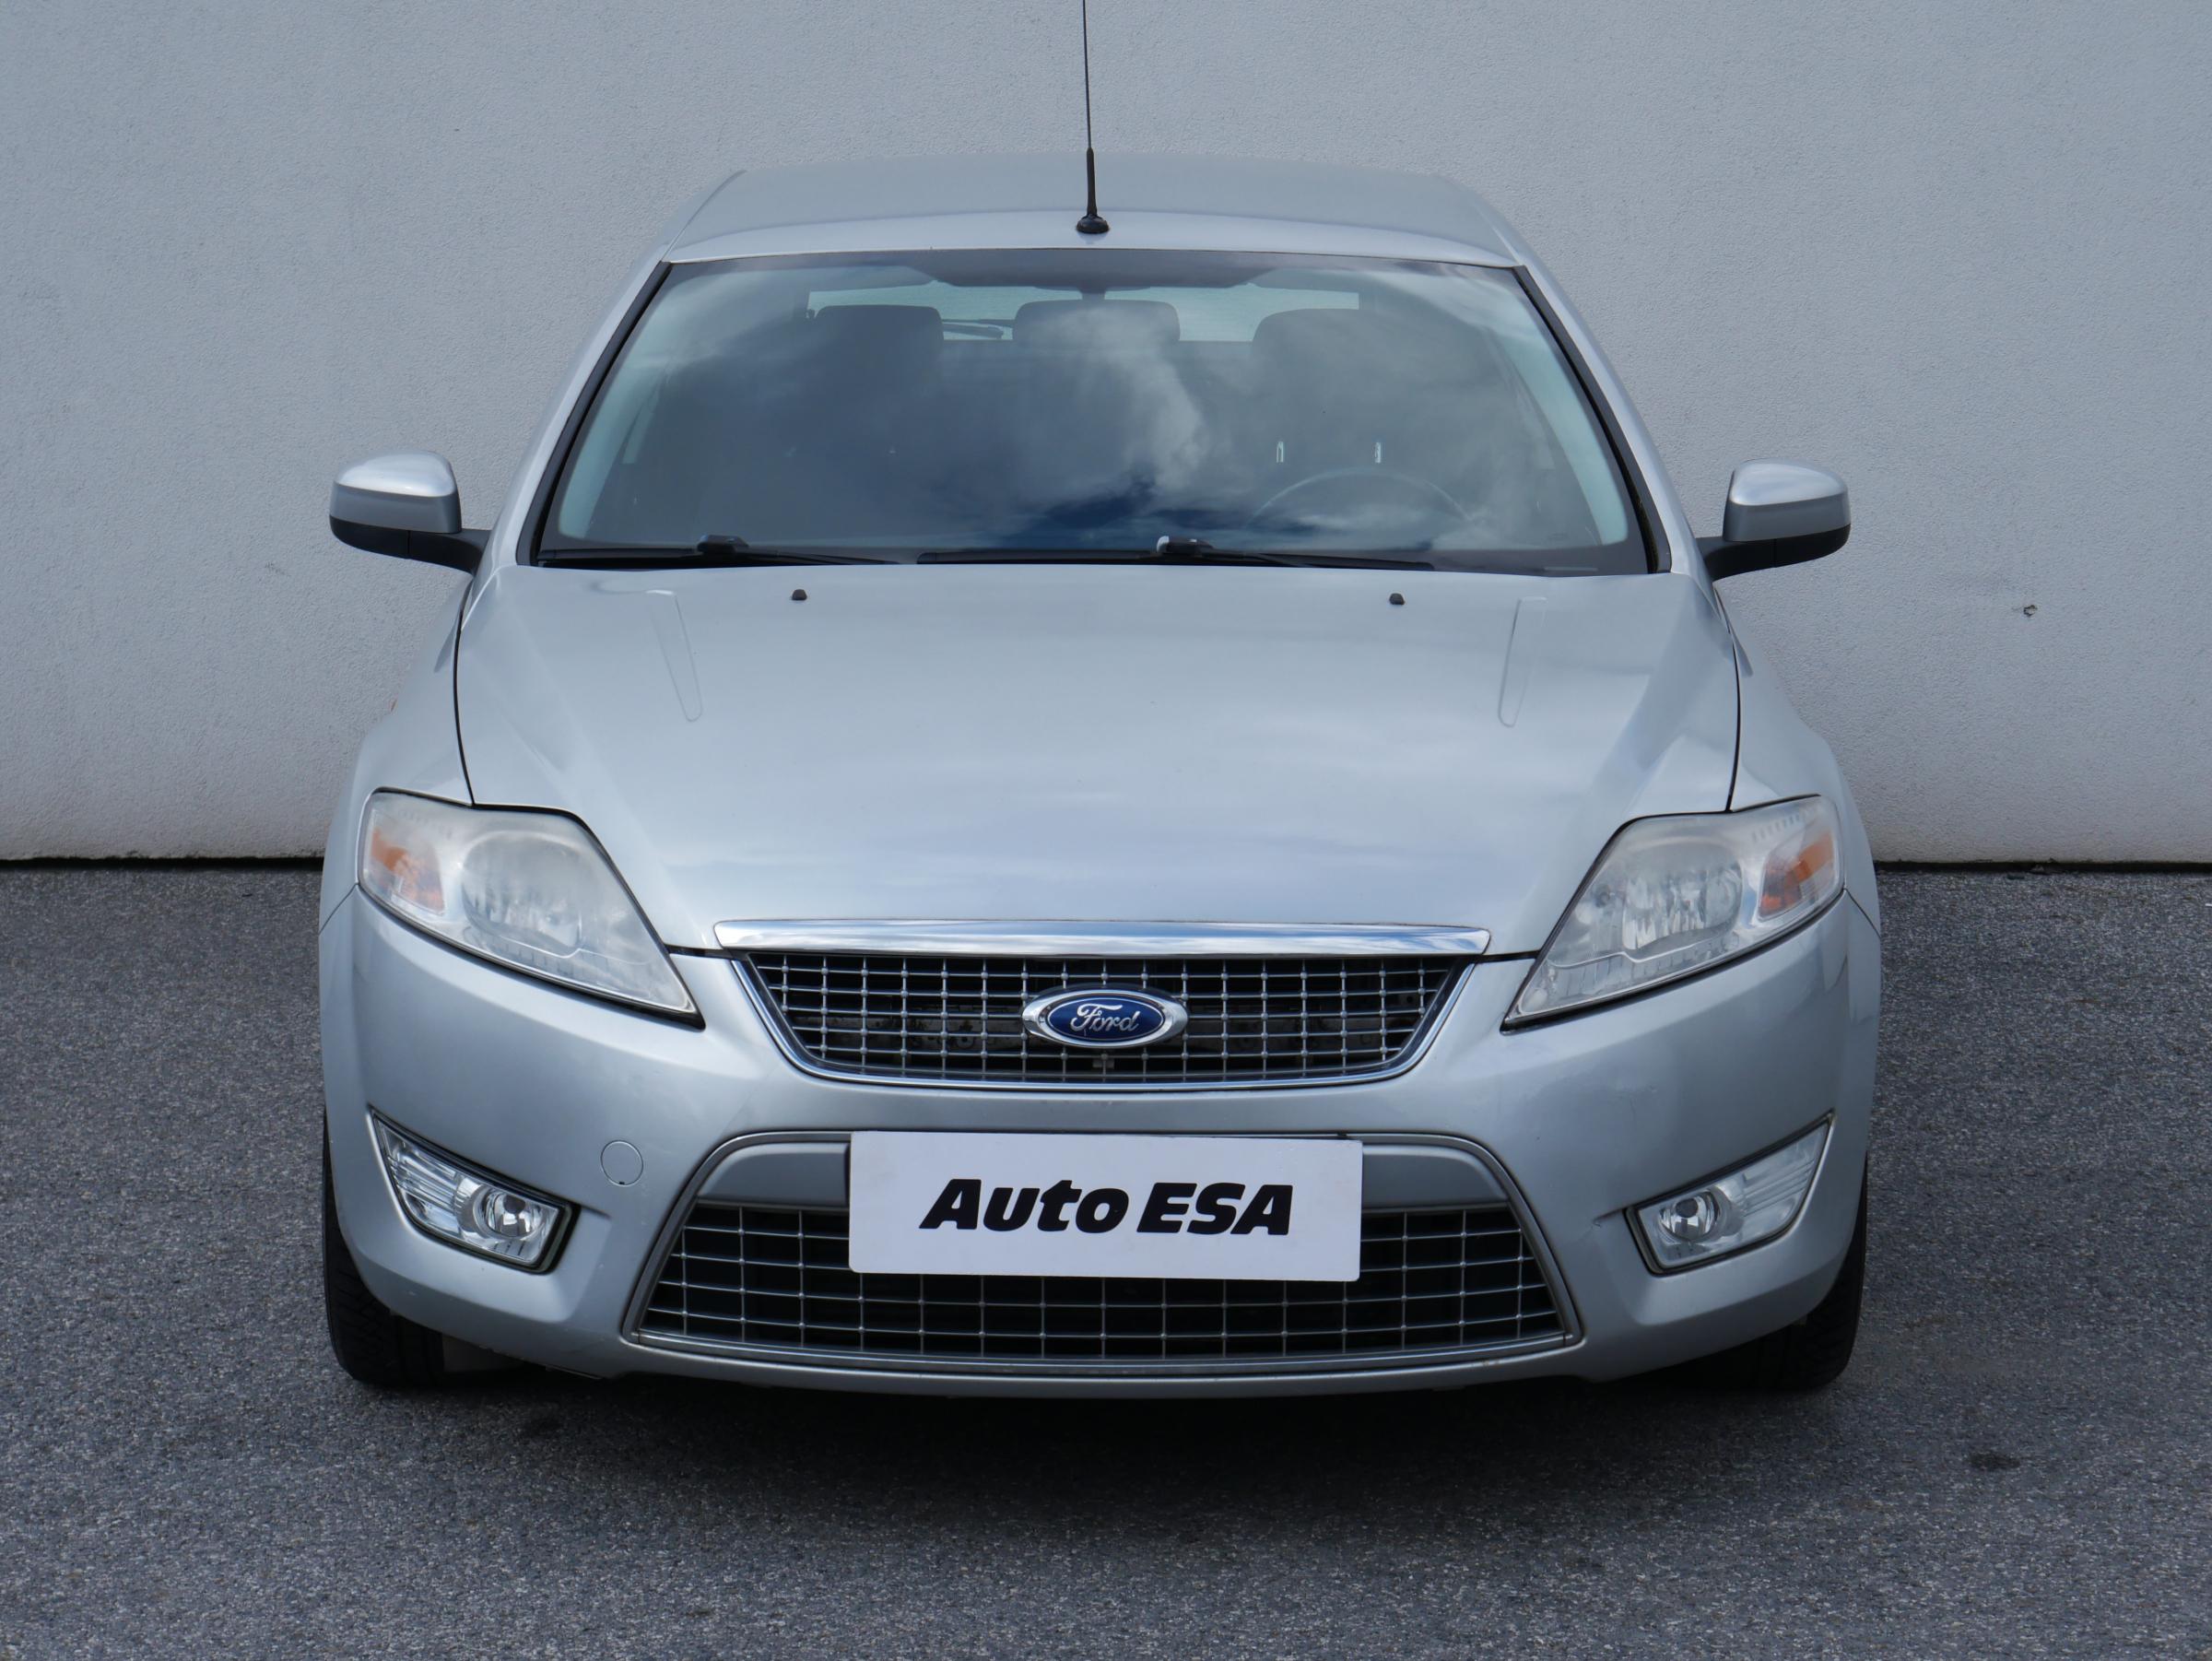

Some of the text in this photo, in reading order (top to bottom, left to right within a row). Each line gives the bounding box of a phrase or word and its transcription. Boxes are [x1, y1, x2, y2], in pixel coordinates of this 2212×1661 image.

[1070, 1003, 1140, 1032] Ford
[919, 1179, 1293, 1235] Auto ESA
